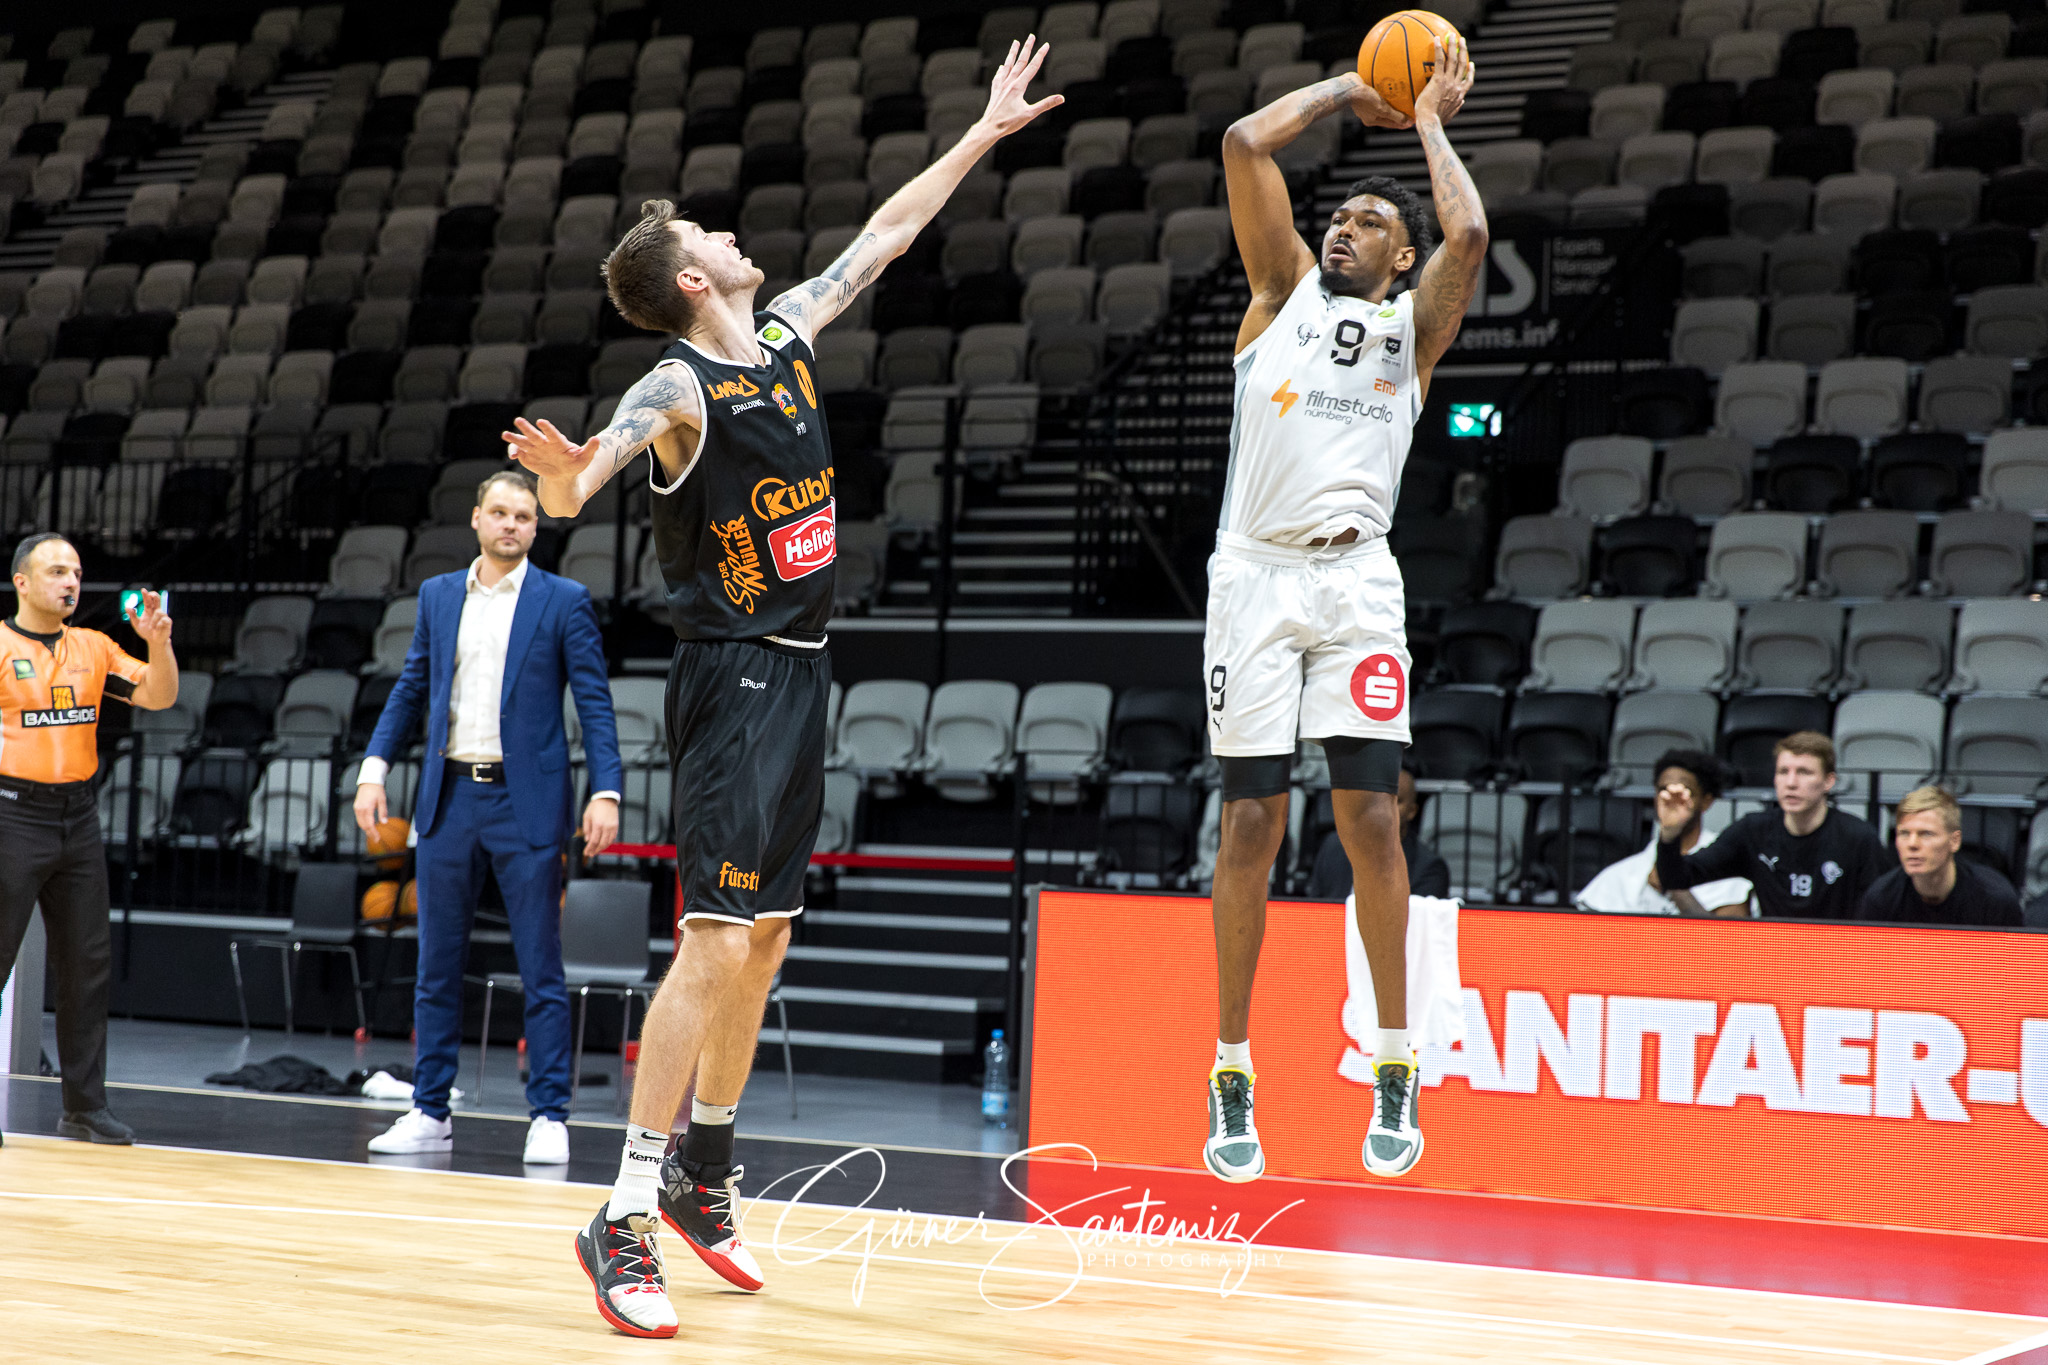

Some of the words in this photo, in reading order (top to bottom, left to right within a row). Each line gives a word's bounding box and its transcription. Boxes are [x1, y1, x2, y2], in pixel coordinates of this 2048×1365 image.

[1330, 319, 1366, 367] 9
[731, 399, 765, 415] SPALDING
[1305, 390, 1393, 423] filmstudio
[710, 520, 760, 614] Sport
[727, 514, 768, 591] MÜLLER
[718, 561, 730, 579] DER
[1210, 665, 1226, 711] 9
[24, 708, 96, 726] BALLSIDE
[1789, 873, 1812, 897] 19
[1337, 986, 2048, 1129] SANITAER-
[628, 1150, 663, 1165] Kemp
